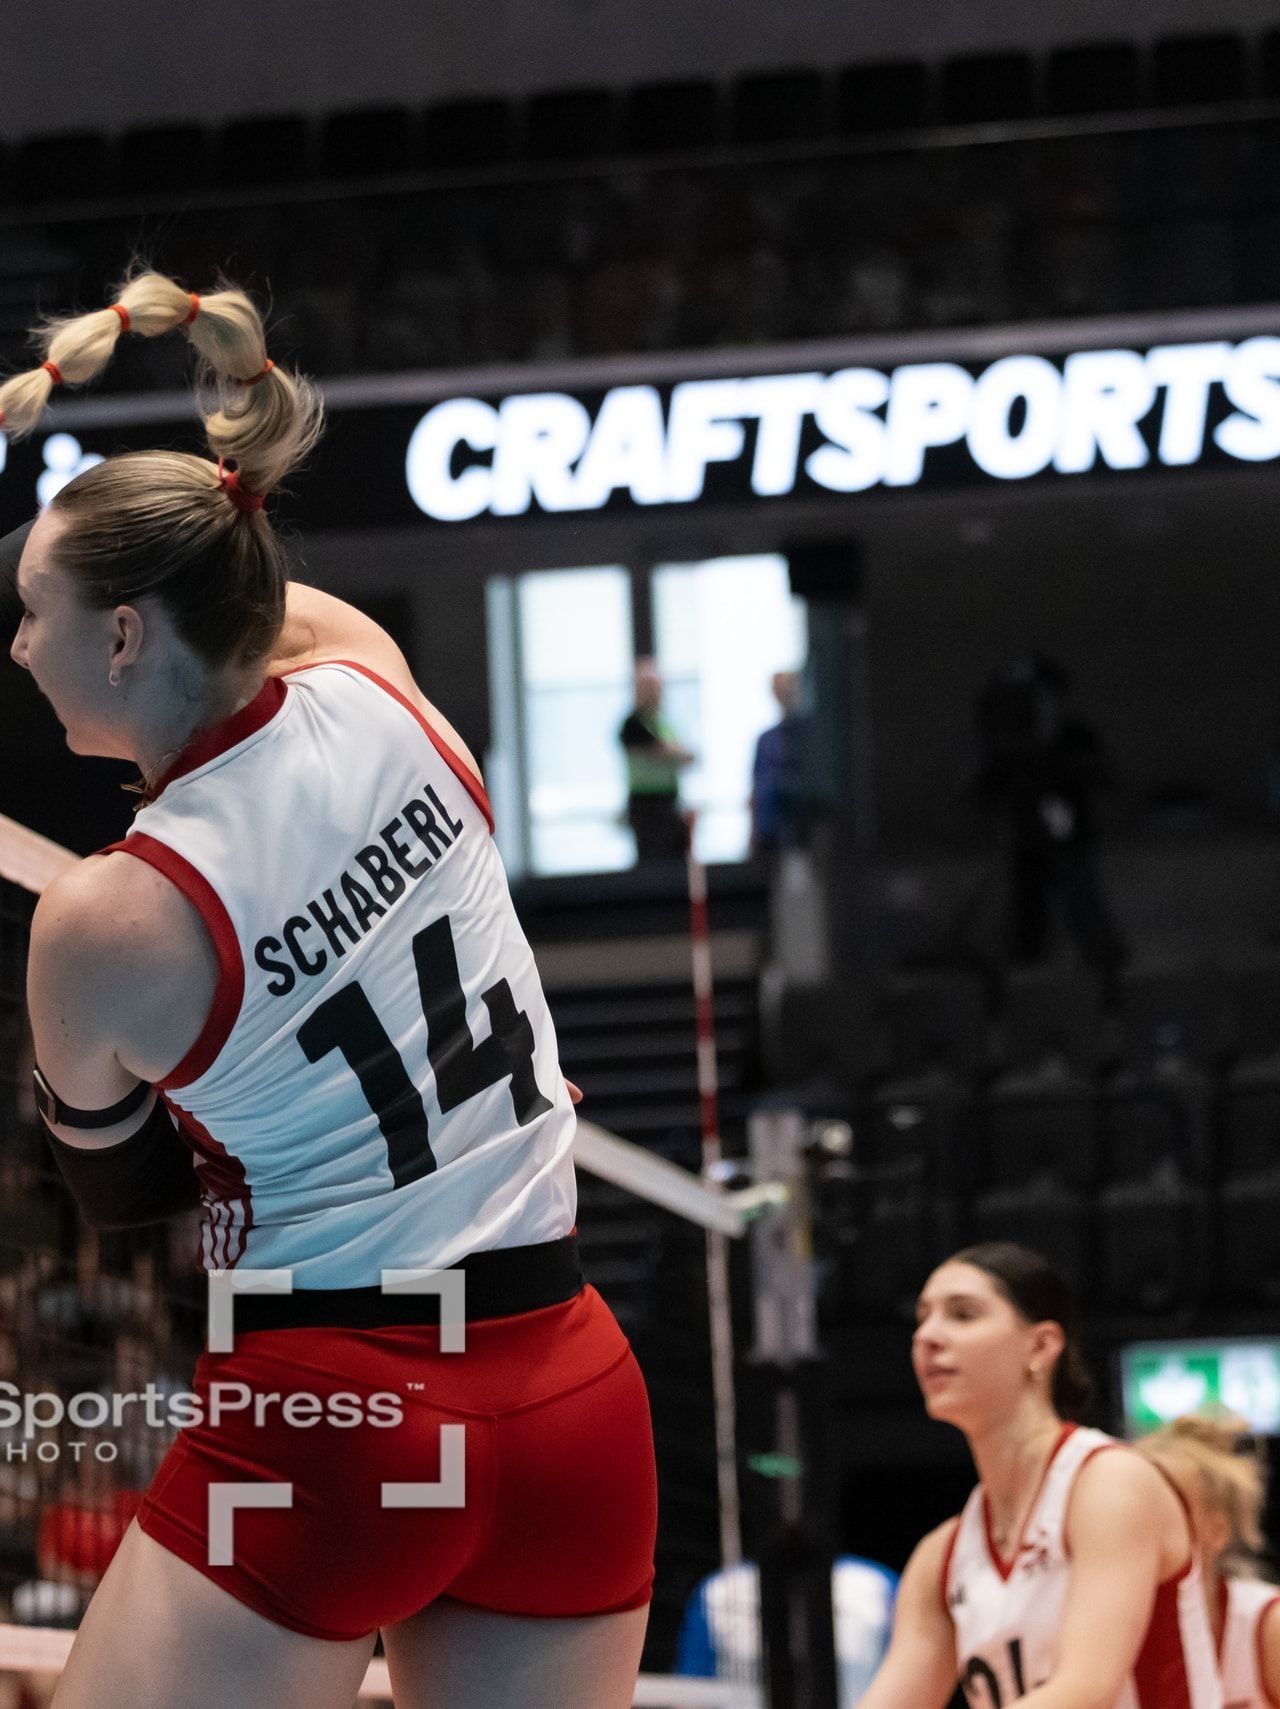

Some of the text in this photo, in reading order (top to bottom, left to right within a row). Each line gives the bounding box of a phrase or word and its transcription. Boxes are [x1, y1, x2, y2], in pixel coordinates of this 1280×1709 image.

[405, 336, 1280, 522] CRAFTSPORTS
[254, 783, 464, 997] SCHABERL
[296, 914, 554, 1190] 14
